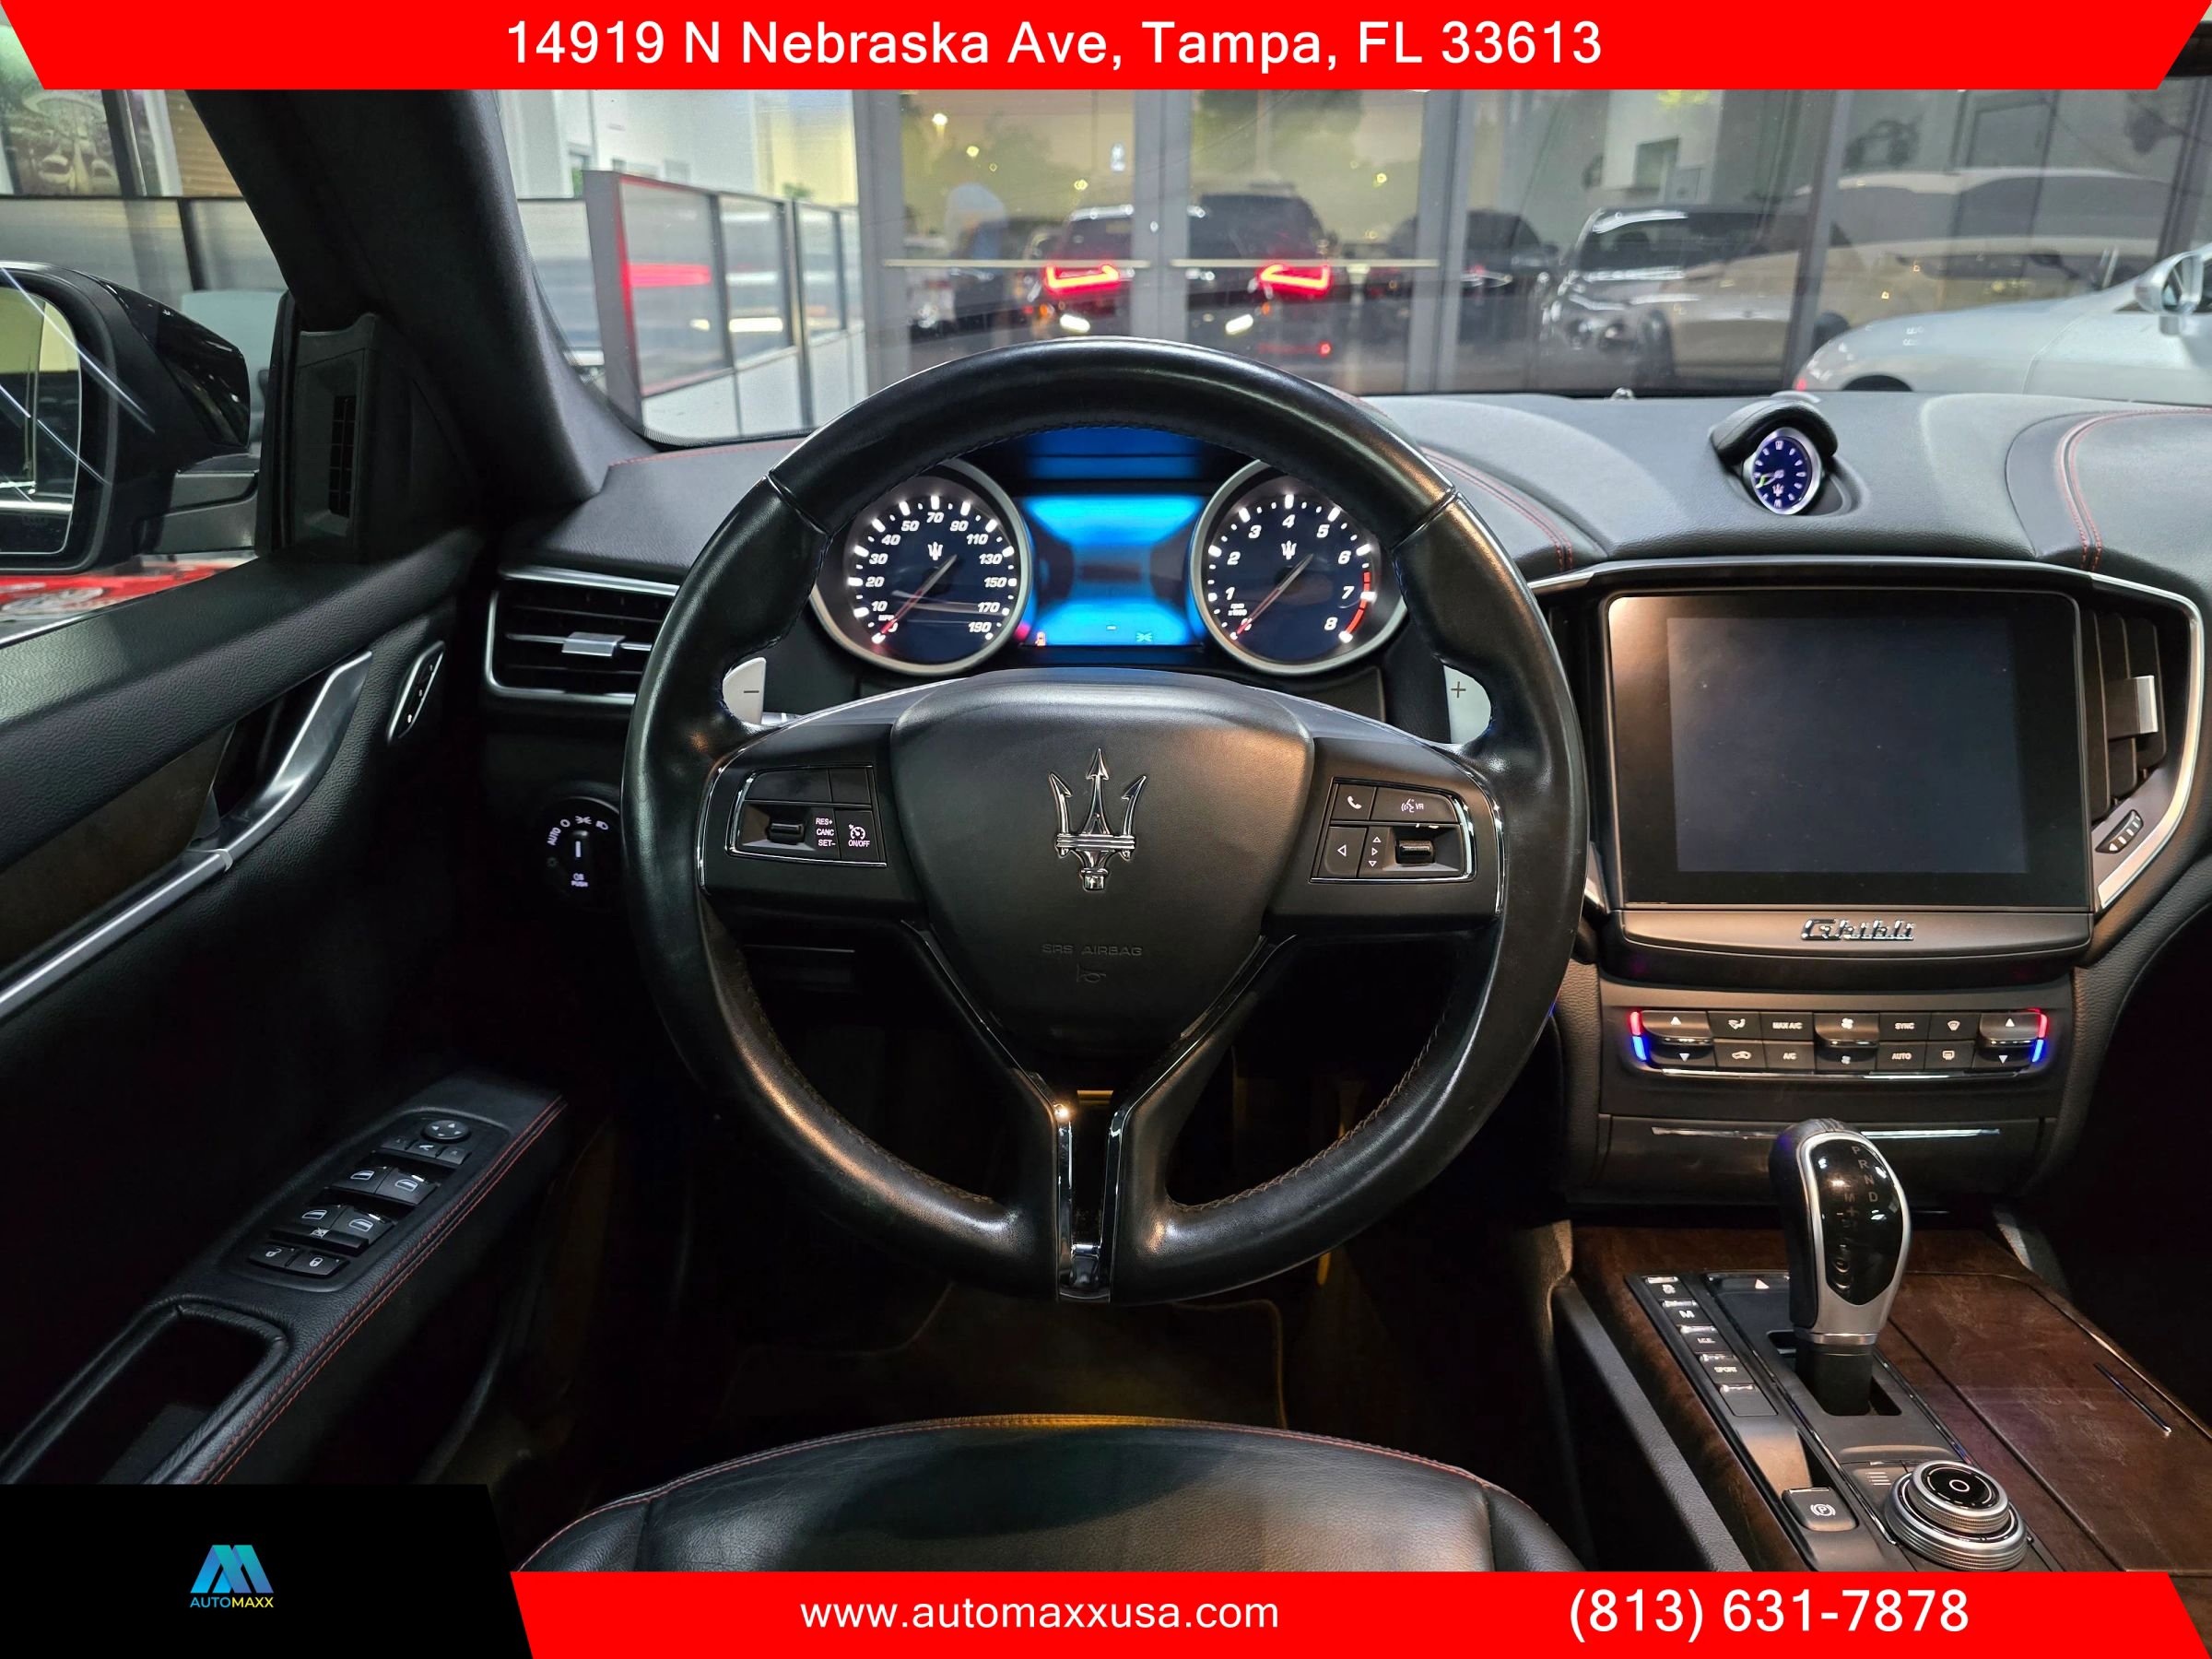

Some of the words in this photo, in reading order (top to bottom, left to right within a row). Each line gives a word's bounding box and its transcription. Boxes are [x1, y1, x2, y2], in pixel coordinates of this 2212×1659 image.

[926, 512, 944, 524] 70
[1282, 514, 1295, 528] 4
[901, 520, 920, 532] 50
[950, 520, 968, 532] 90
[1248, 524, 1262, 539] 3
[1316, 524, 1330, 538] 5
[881, 534, 900, 546] 40
[967, 534, 988, 545] 110
[869, 553, 888, 565] 30
[979, 553, 1002, 565] 130
[1227, 551, 1241, 566] 2
[1338, 550, 1351, 564] 6
[865, 576, 885, 588] 20
[983, 577, 1007, 588] 150
[1225, 586, 1235, 601] 1
[1341, 585, 1355, 600] 7
[871, 600, 888, 612] 10
[977, 602, 1000, 613] 170
[968, 622, 992, 633] 190
[1324, 617, 1338, 631] 8
[816, 829, 835, 837] CANC
[848, 840, 871, 848] ON/OFF
[1801, 918, 1916, 941] Ghibli
[1041, 943, 1075, 955] SRS
[1081, 946, 1144, 957] AIRBAG
[1895, 1022, 1915, 1030] SYNC
[1783, 1052, 1796, 1060] A/C
[1891, 1052, 1912, 1061] AUTO
[1858, 1159, 1869, 1170] R
[1864, 1174, 1875, 1185] N
[1868, 1191, 1878, 1203] D
